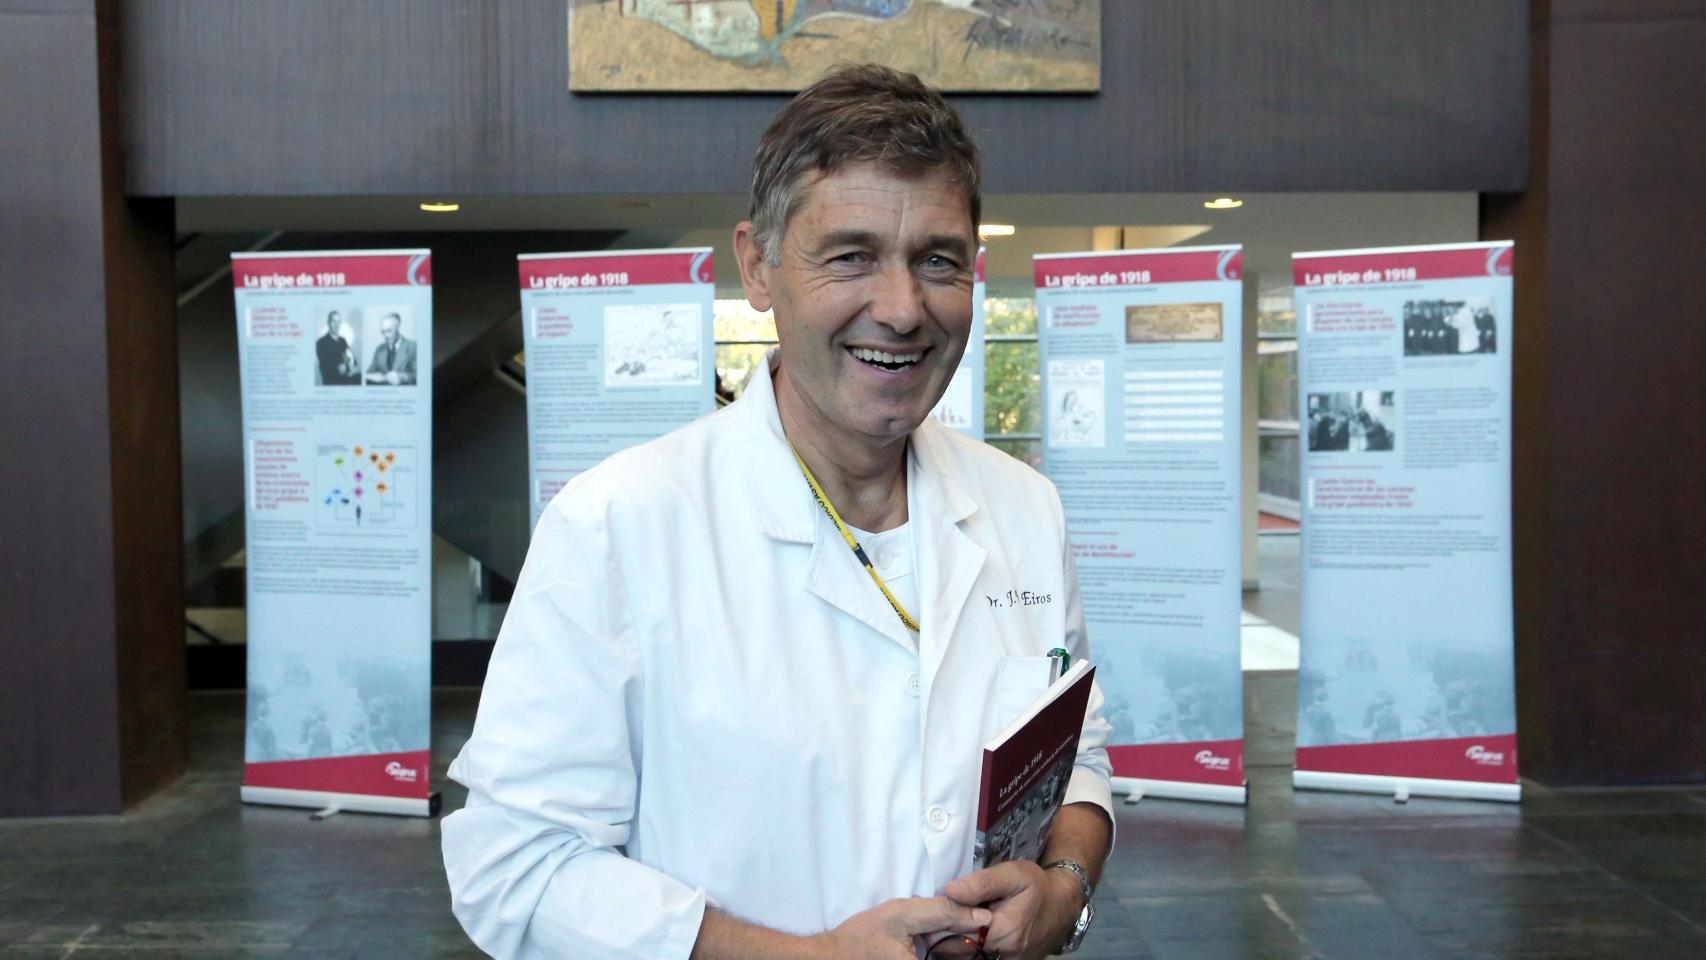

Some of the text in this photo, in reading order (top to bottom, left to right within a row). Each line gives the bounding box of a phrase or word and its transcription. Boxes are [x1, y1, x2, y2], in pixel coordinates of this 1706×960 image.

[243, 272, 346, 289] La gripe de 1918
[529, 271, 629, 290] La gripe de 1918
[1044, 270, 1151, 288] La gripe de 1918
[1305, 267, 1416, 286] La gripe de 1918
[1021, 591, 1052, 605] Eiros
